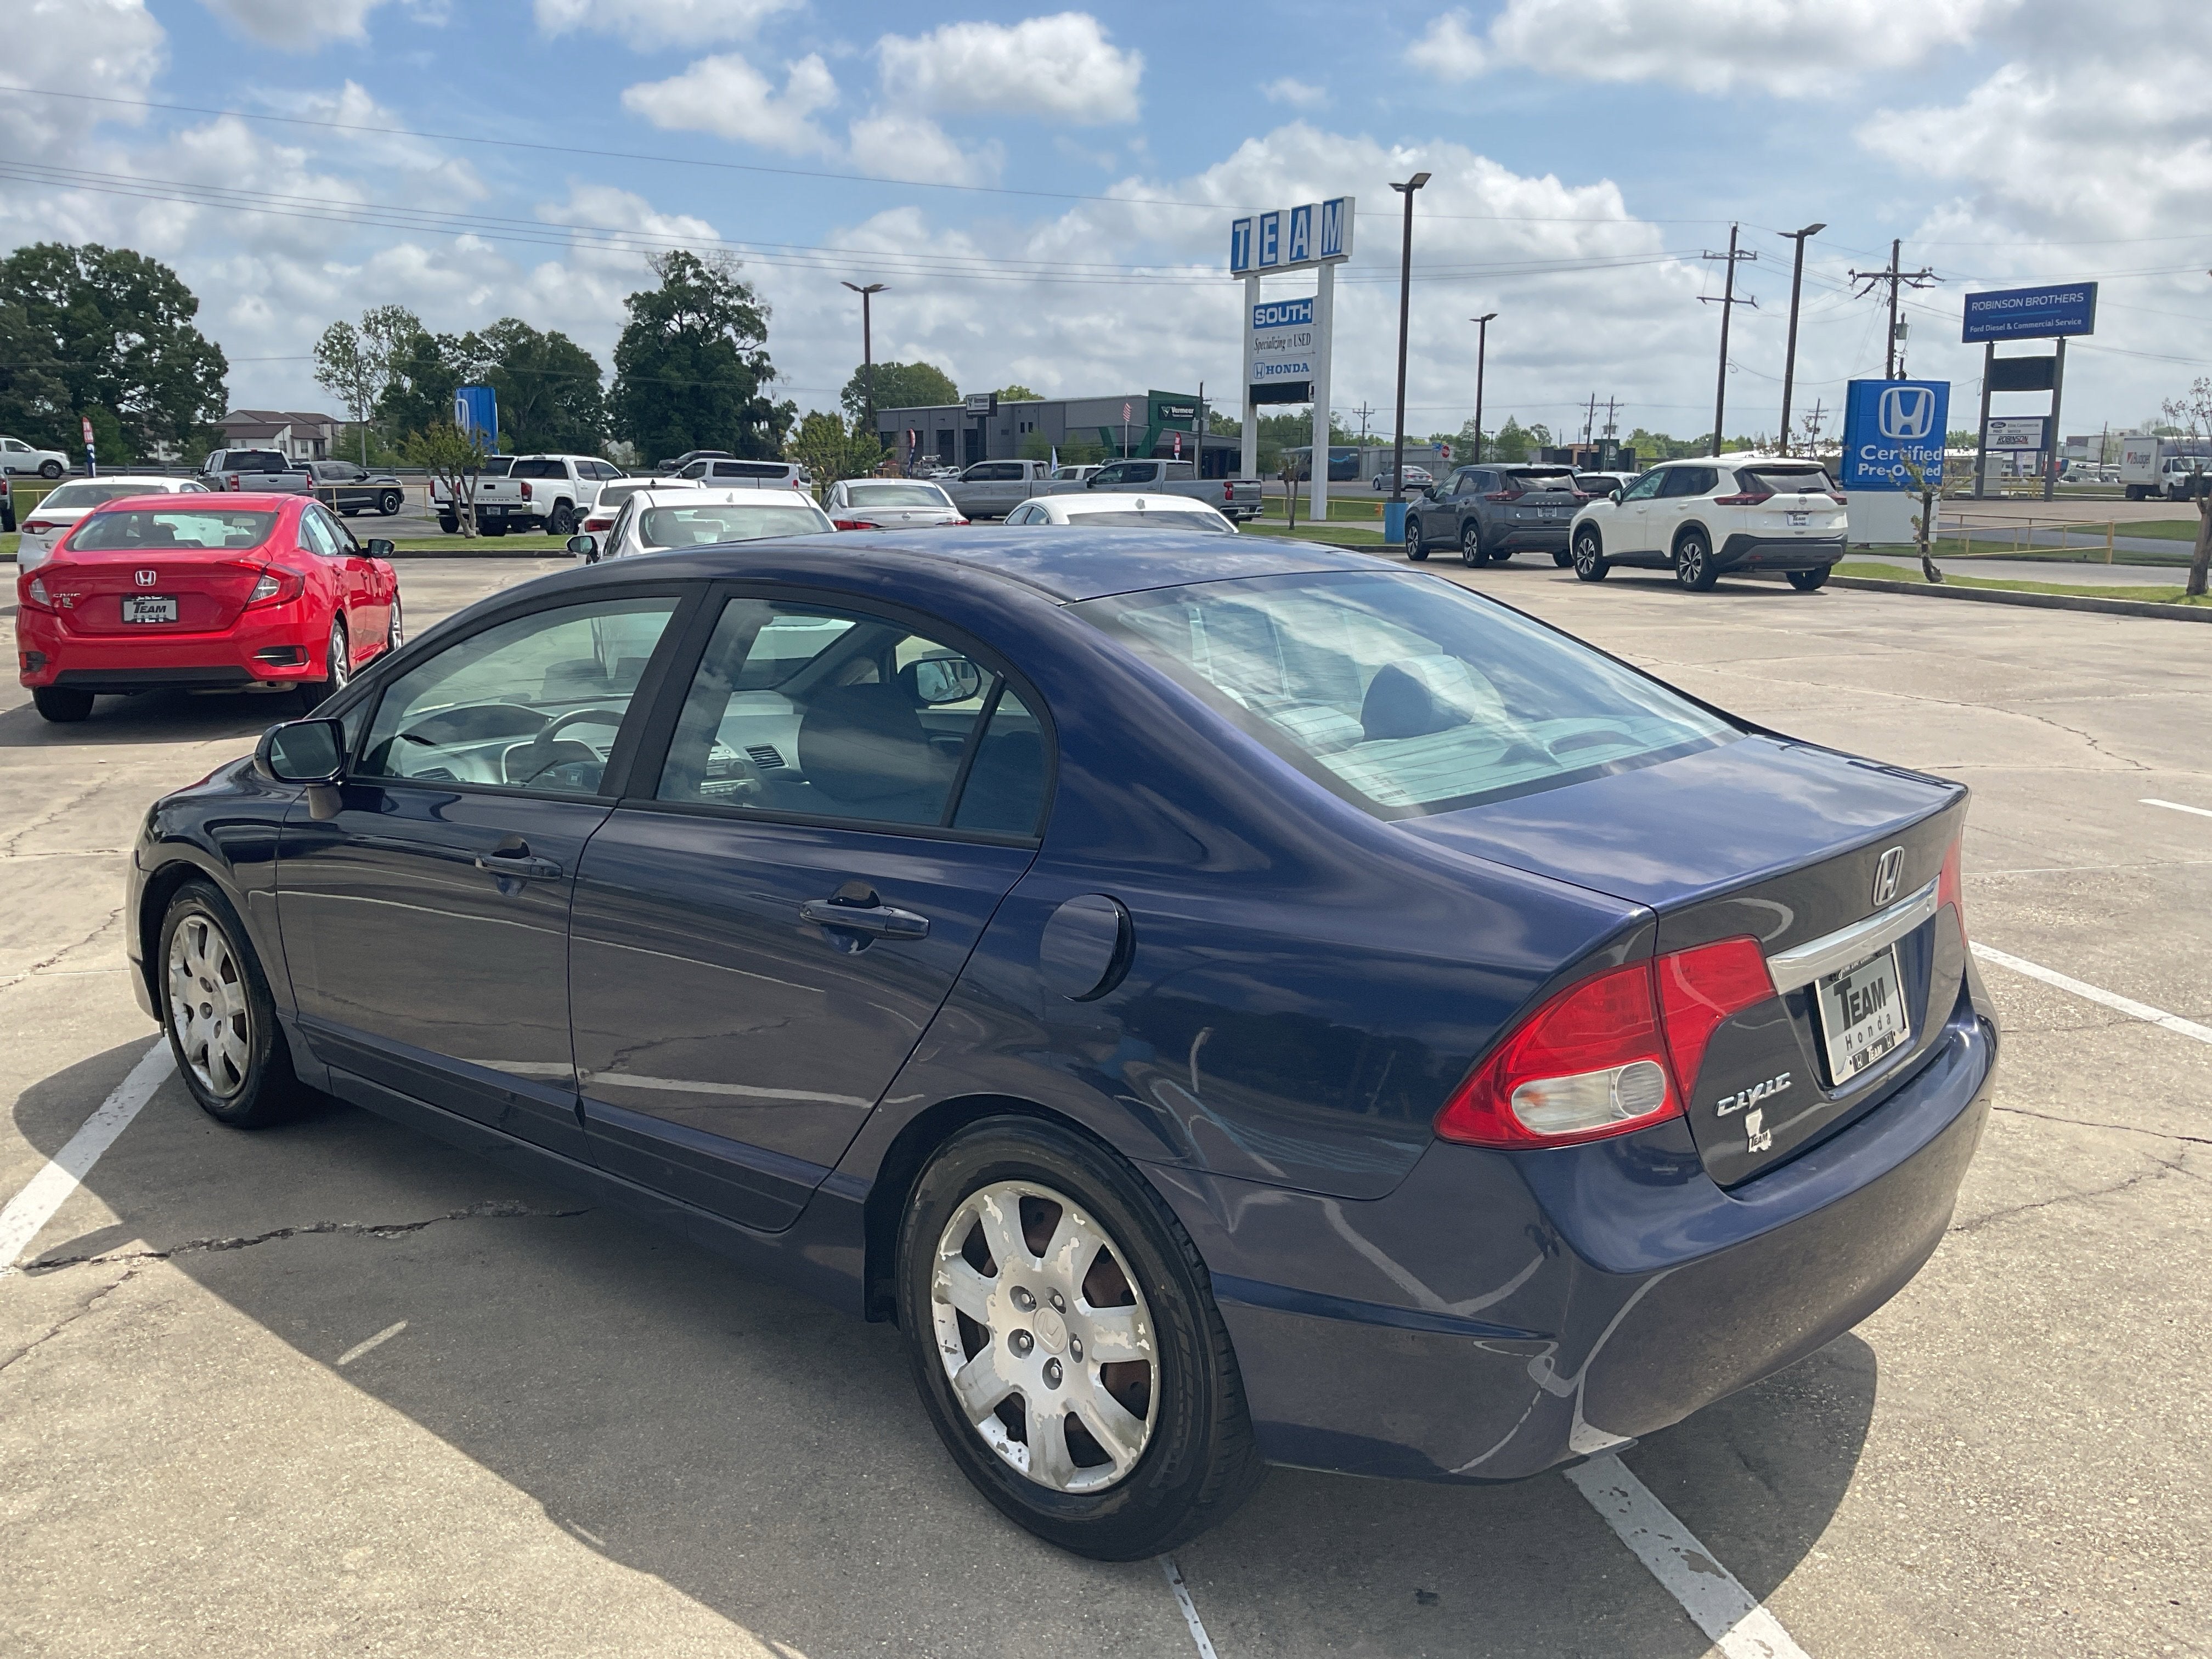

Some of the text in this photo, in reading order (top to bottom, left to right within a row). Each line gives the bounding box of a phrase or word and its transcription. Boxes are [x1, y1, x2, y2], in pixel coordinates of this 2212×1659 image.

[1234, 202, 1343, 267] TEAM
[1972, 292, 2084, 311] ROBINSON BROTHERS
[1255, 303, 1311, 325] SOUTH
[1970, 324, 1984, 332] Ford
[1985, 323, 2005, 331] Diesel
[2013, 319, 2053, 329] Commercial
[2055, 318, 2082, 326] Service
[1254, 332, 1311, 353] Specializing in USED
[1266, 363, 1310, 375] HONDA
[1860, 445, 1943, 461] Certified
[133, 602, 166, 613] TEAM
[1833, 976, 1886, 1031] TEAM
[1845, 1013, 1891, 1051] Honda
[1866, 1045, 1882, 1063] TEAM
[1717, 1072, 1792, 1116] CIVIC
[1750, 1132, 1768, 1148] TEAM
